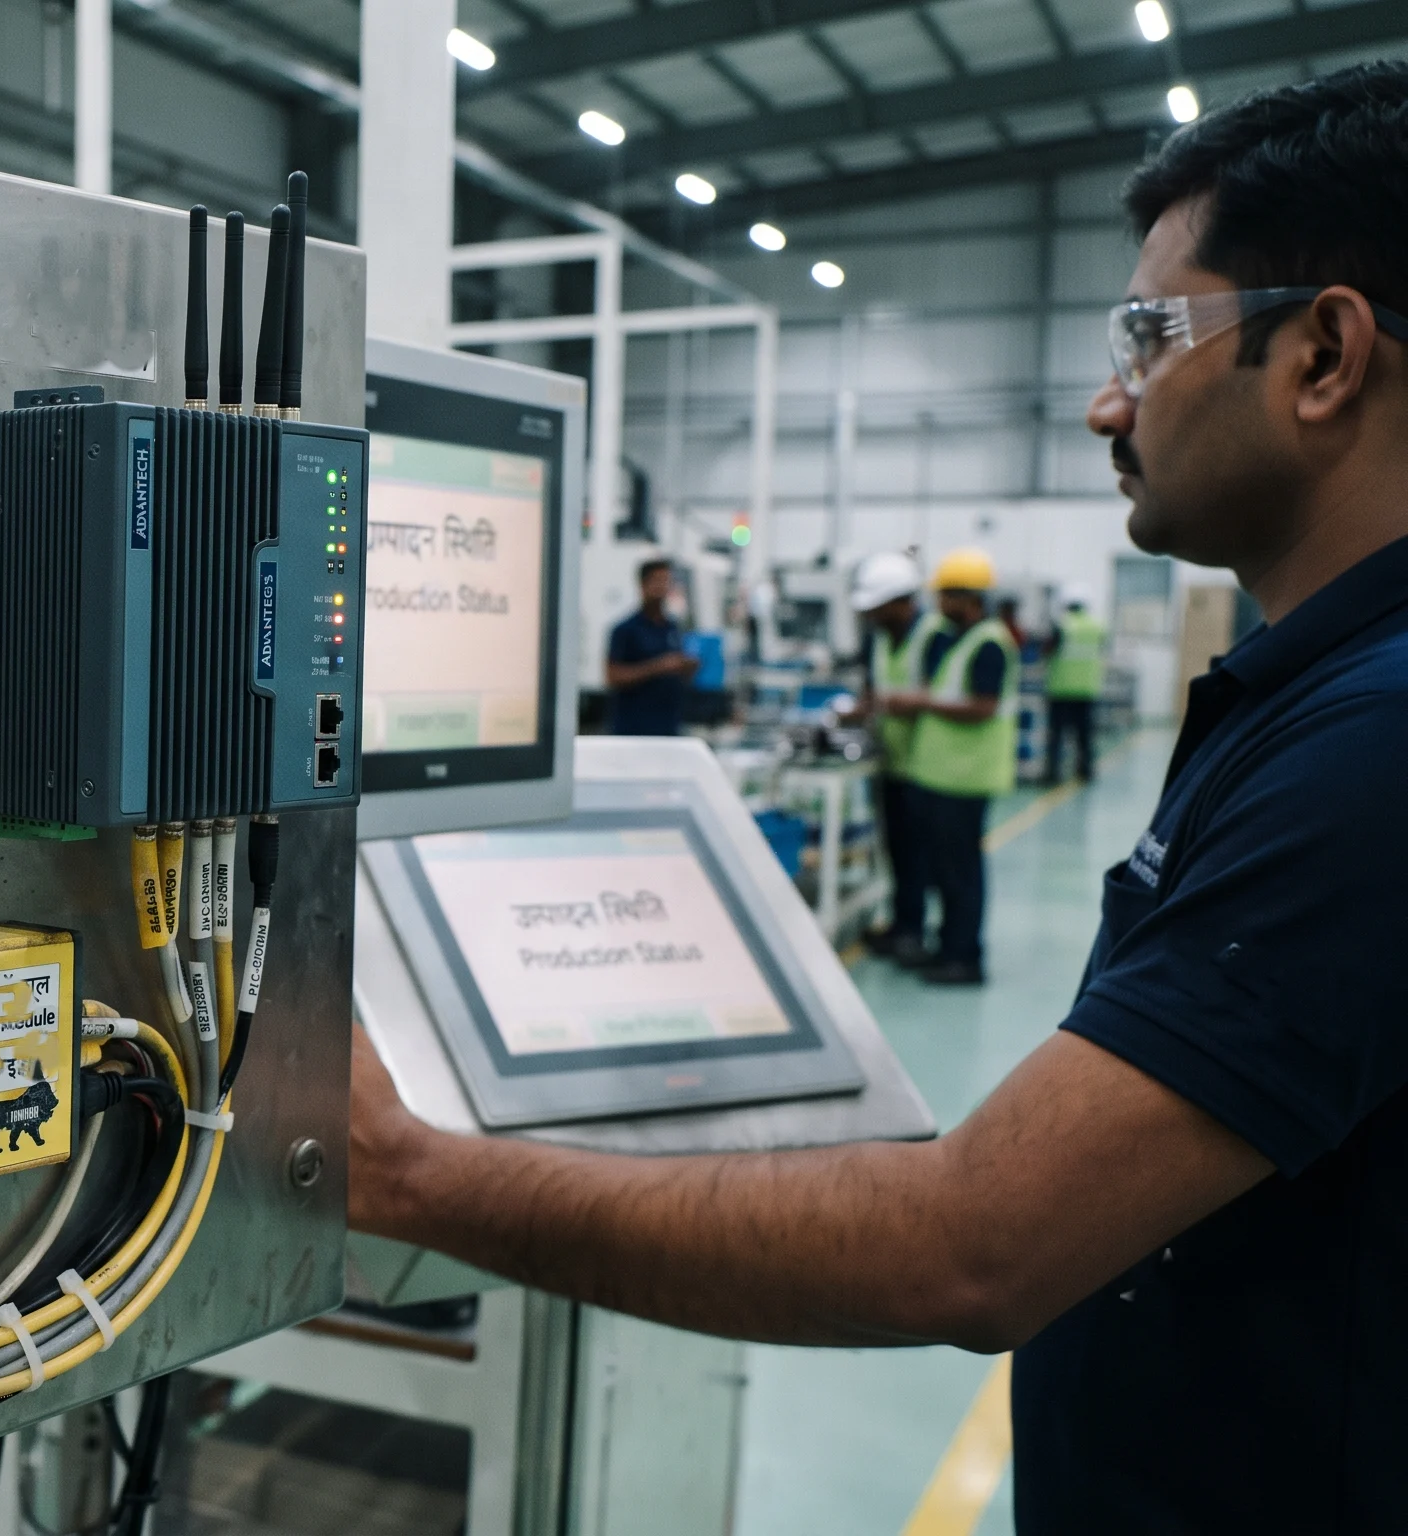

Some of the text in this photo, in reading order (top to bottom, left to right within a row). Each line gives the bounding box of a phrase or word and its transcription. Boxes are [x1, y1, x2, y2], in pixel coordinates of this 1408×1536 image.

[135, 448, 149, 539] ADVANTECH
[366, 582, 509, 616] roduction Status
[517, 940, 704, 970] Production Status
